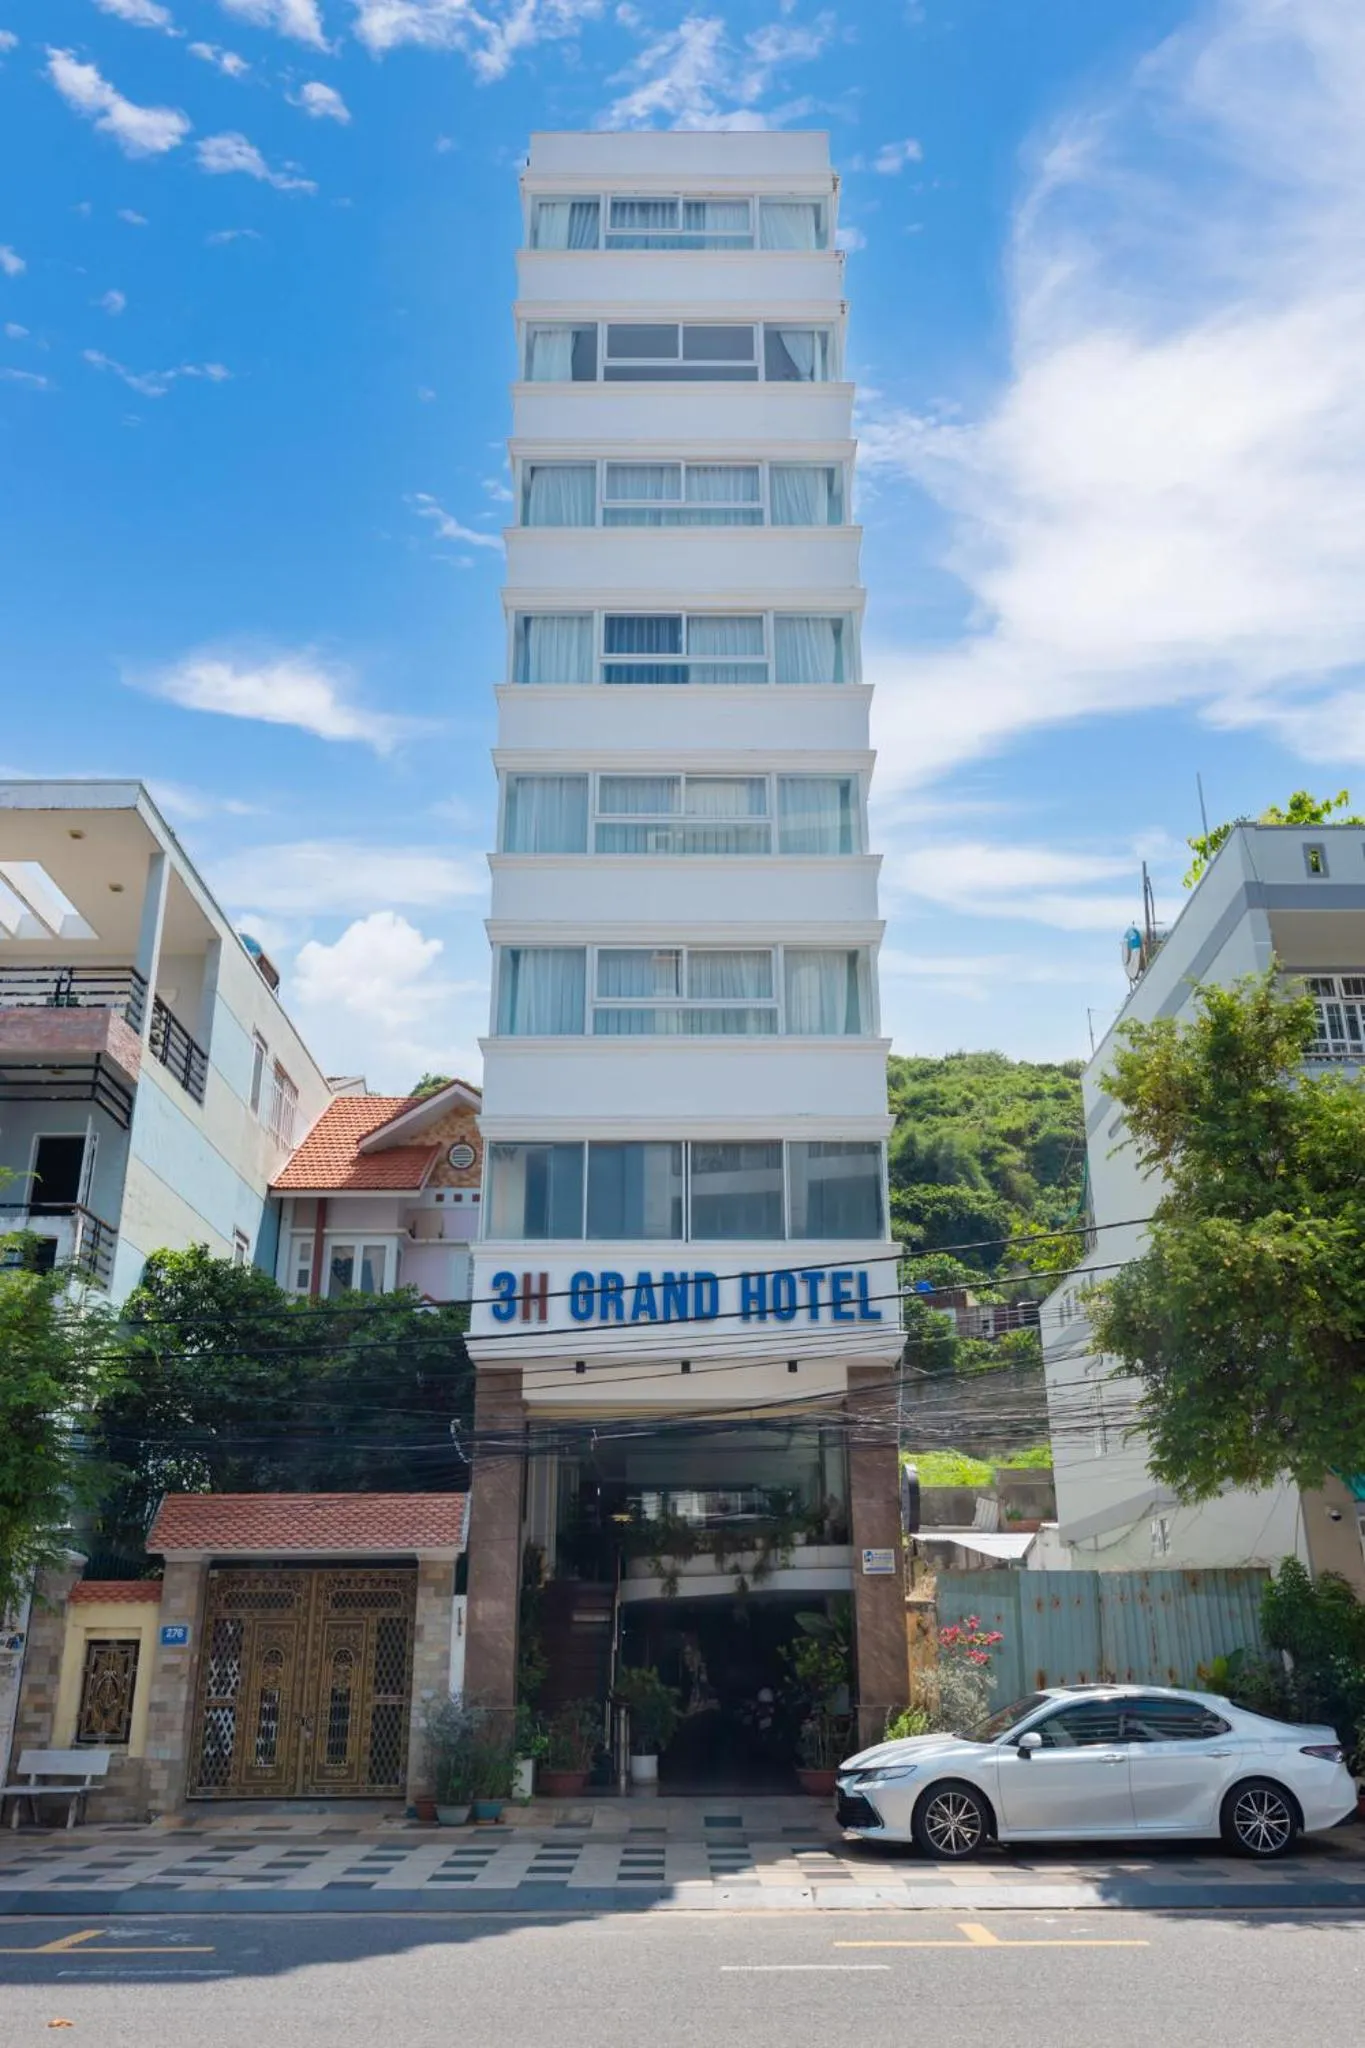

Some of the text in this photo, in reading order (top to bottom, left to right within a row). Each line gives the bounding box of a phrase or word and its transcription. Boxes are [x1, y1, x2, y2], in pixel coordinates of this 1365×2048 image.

[491, 1271, 882, 1323] 3H GRAND HOTEL
